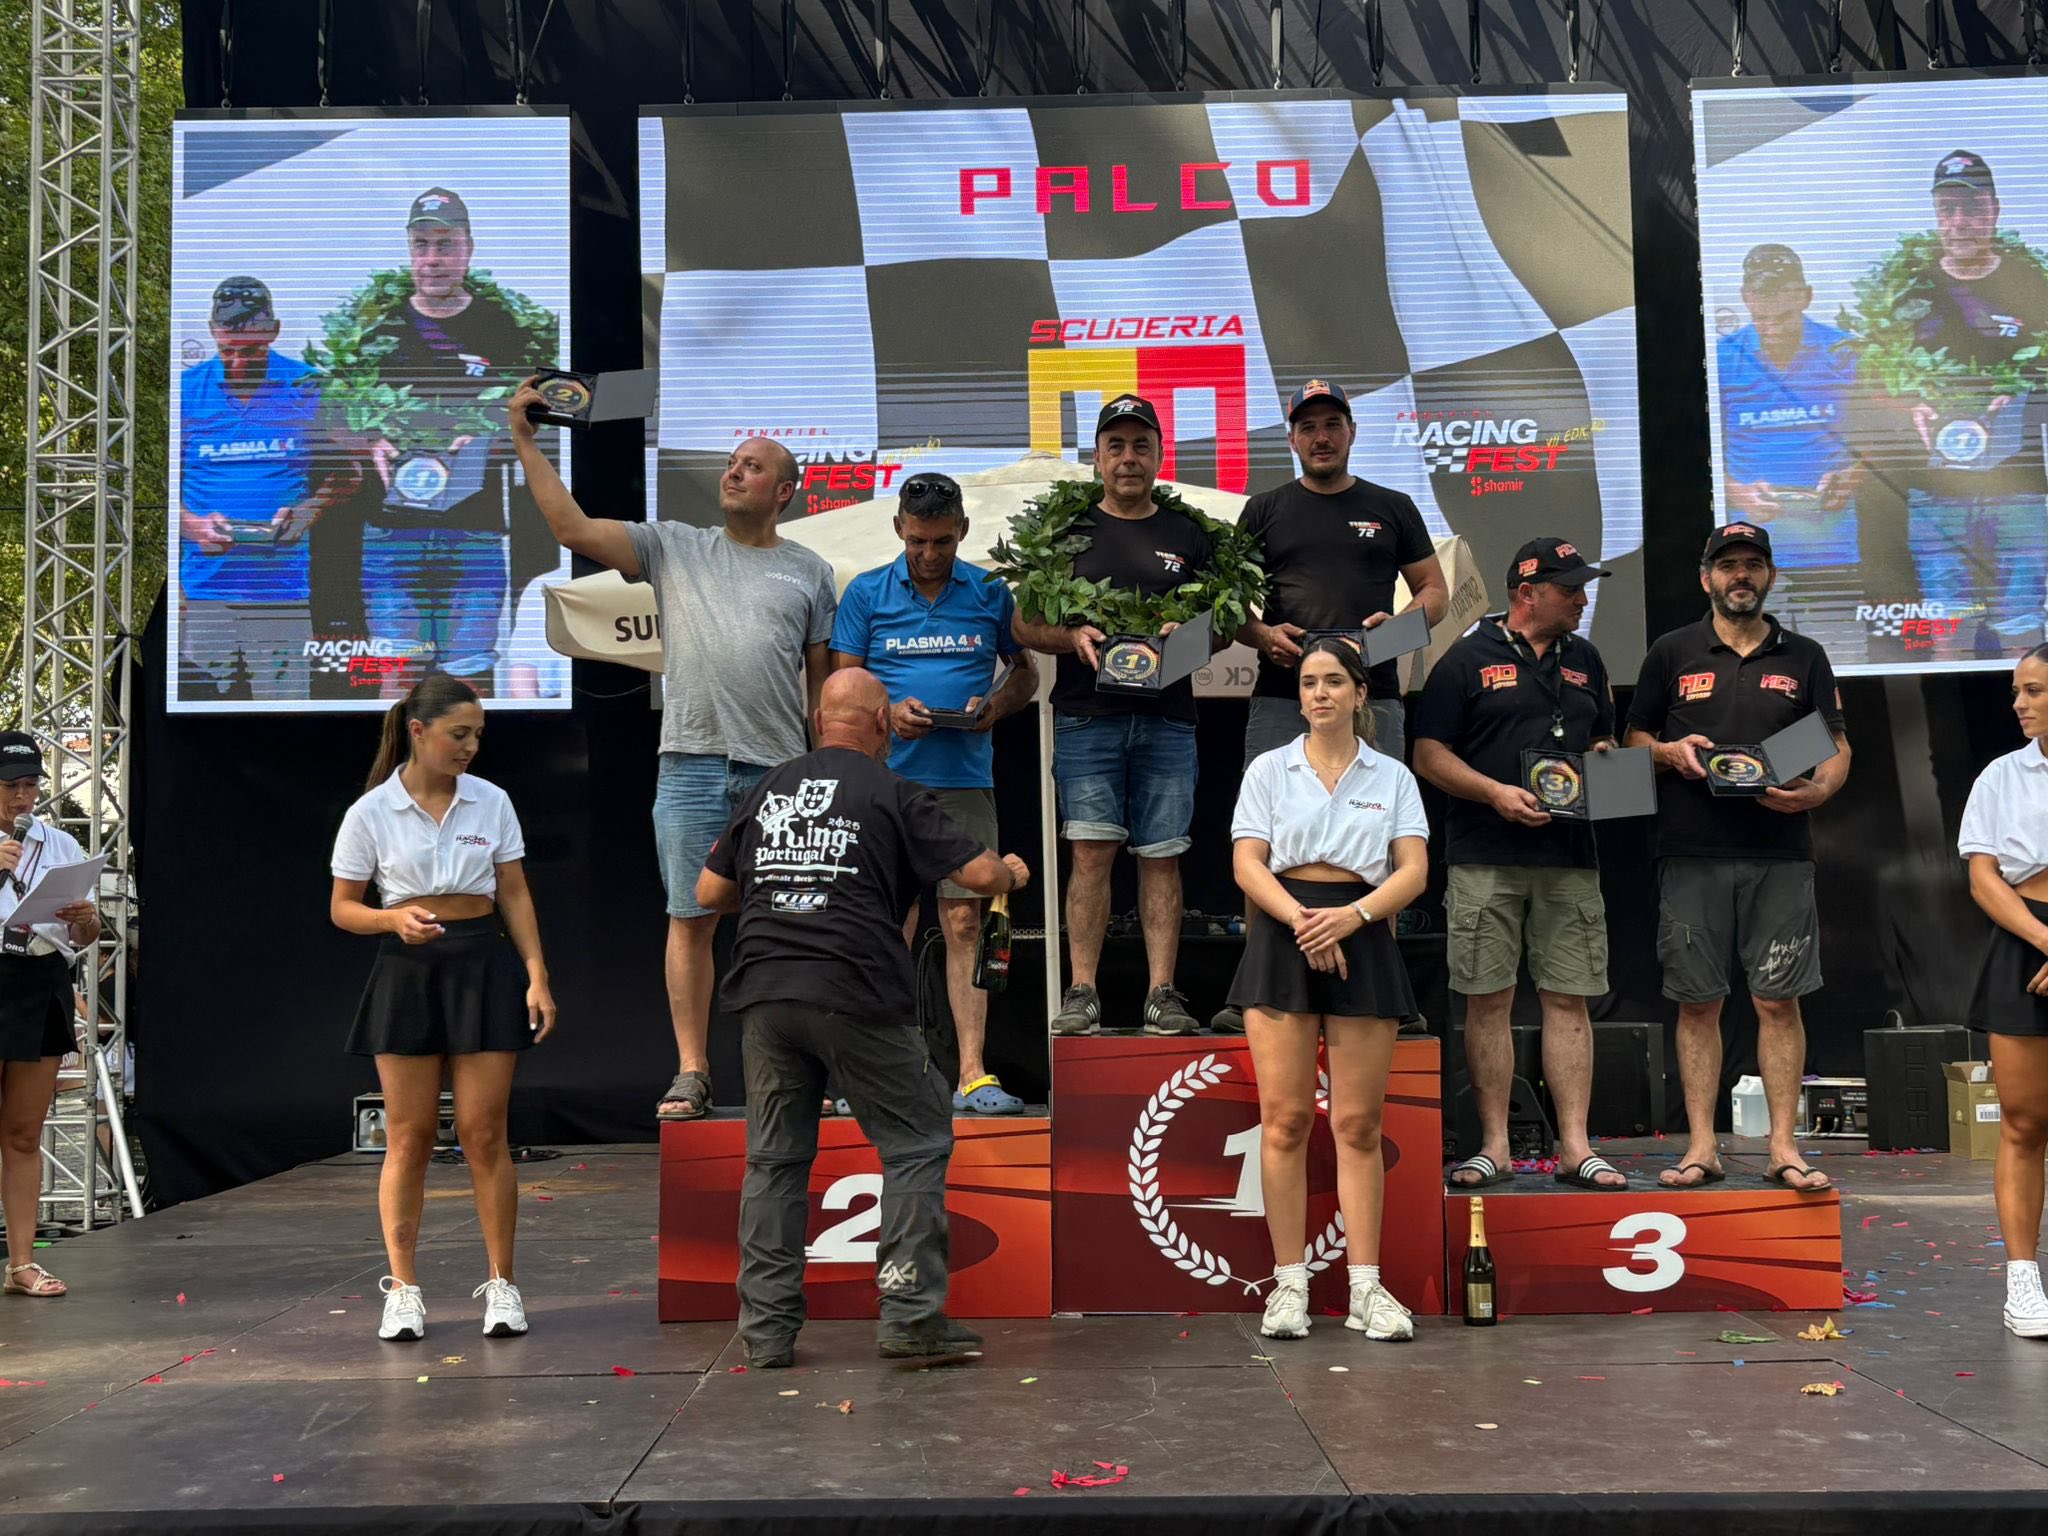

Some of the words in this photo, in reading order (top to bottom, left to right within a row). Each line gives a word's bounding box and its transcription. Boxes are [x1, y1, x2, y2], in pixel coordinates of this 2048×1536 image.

[959, 159, 1311, 215] PALCO
[1028, 314, 1245, 343] SCUDERIA
[735, 428, 829, 437] PENAFIEL
[1392, 418, 1538, 447] RACING
[1466, 445, 1568, 473] FEST
[803, 464, 903, 490] FEST
[1358, 528, 1375, 538] 72
[1164, 560, 1181, 573] 72
[1856, 603, 1945, 620] RACING
[1902, 618, 1964, 636] FEST
[303, 640, 393, 657] RACING
[886, 635, 956, 651] PLASMA
[348, 657, 412, 673] FEST
[1479, 664, 1517, 688] MD
[1678, 672, 1716, 698] MD
[1728, 762, 1748, 773] 3
[1547, 774, 1565, 791] 3
[762, 818, 849, 857] King
[755, 846, 827, 866] Portugal
[5, 943, 25, 953] ORG
[805, 1173, 884, 1263] 2
[1602, 1212, 1687, 1293] 3
